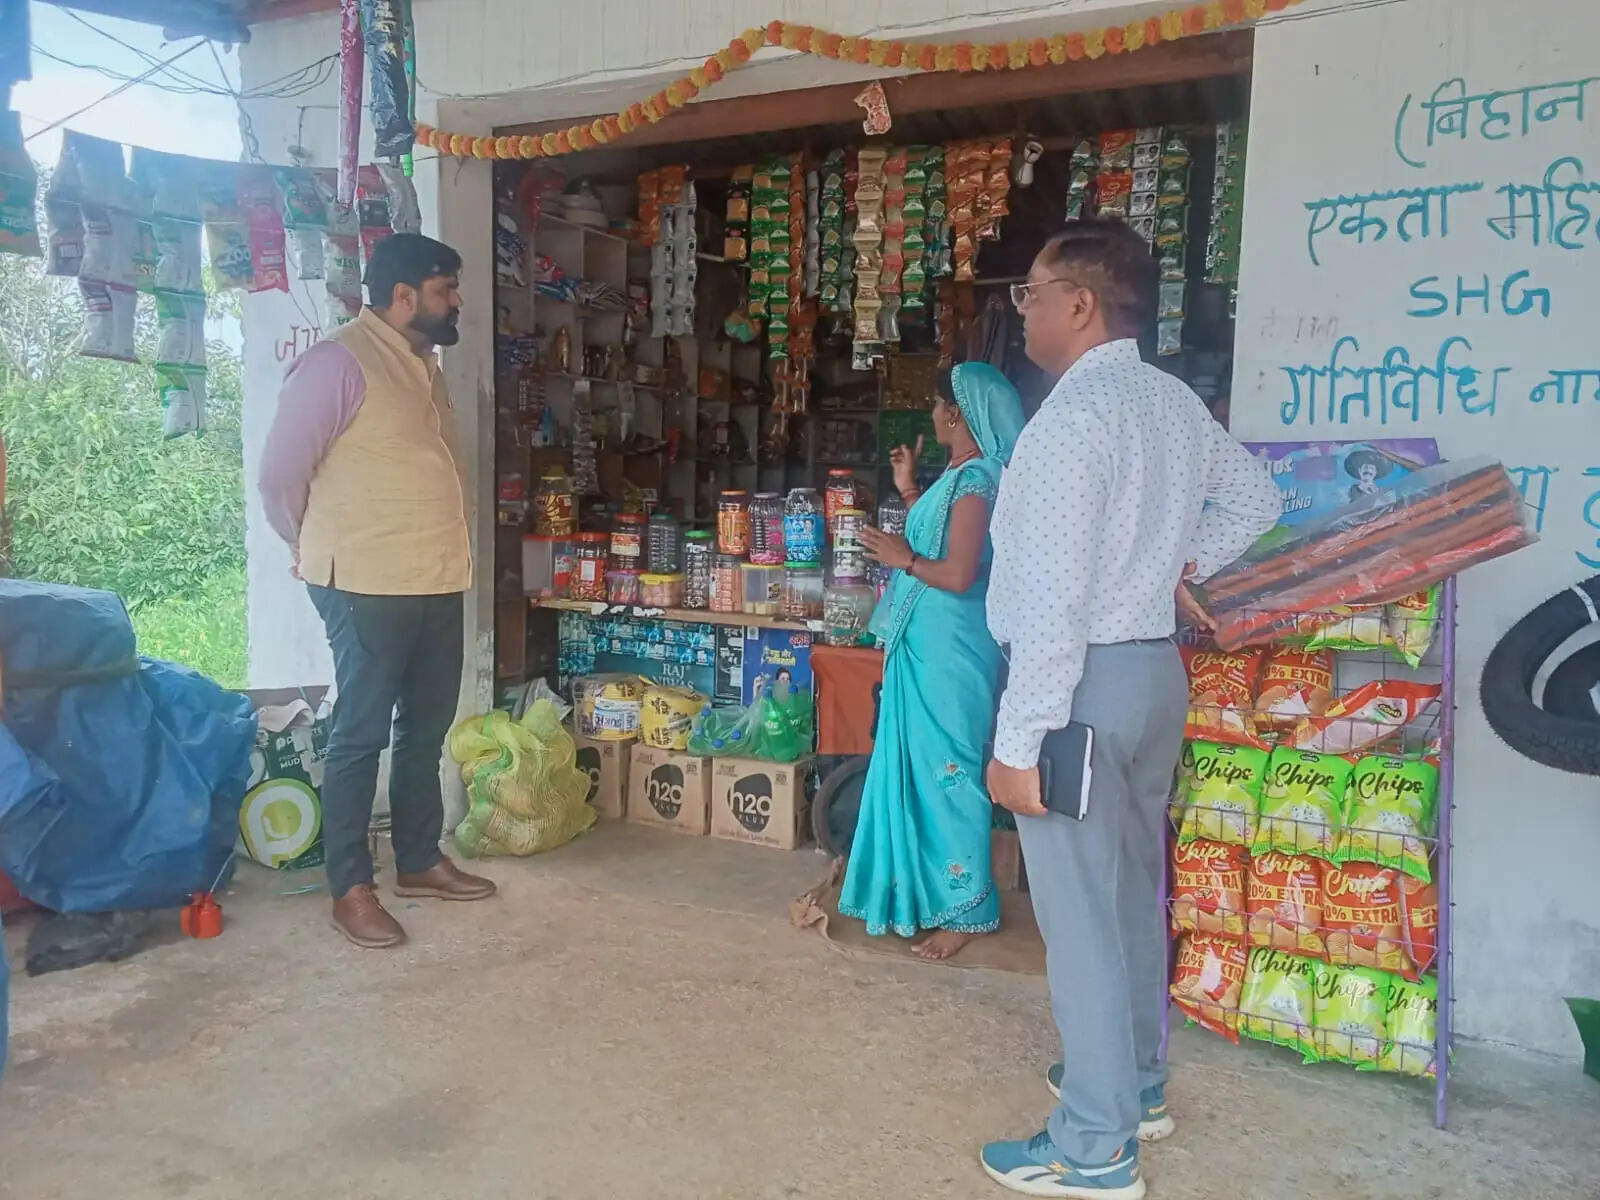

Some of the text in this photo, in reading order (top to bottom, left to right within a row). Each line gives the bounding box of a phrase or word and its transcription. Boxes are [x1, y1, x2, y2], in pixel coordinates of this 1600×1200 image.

[1303, 156, 1600, 267] एकता महि
[1406, 269, 1550, 319] SHG
[1279, 335, 1513, 425] गतिविधि
[662, 662, 687, 678] RAJ
[1190, 652, 1248, 674] Chips
[1290, 668, 1330, 689] EXTRA
[1195, 756, 1254, 785] Chips
[1275, 762, 1337, 795] Chips
[1358, 771, 1425, 801] Chips
[1174, 841, 1231, 868] Chips
[1254, 852, 1312, 885] Chips
[1325, 868, 1387, 904] Chips
[1351, 907, 1399, 923] EXTRA
[1251, 947, 1314, 981] Chips
[1315, 971, 1378, 1008] Chips
